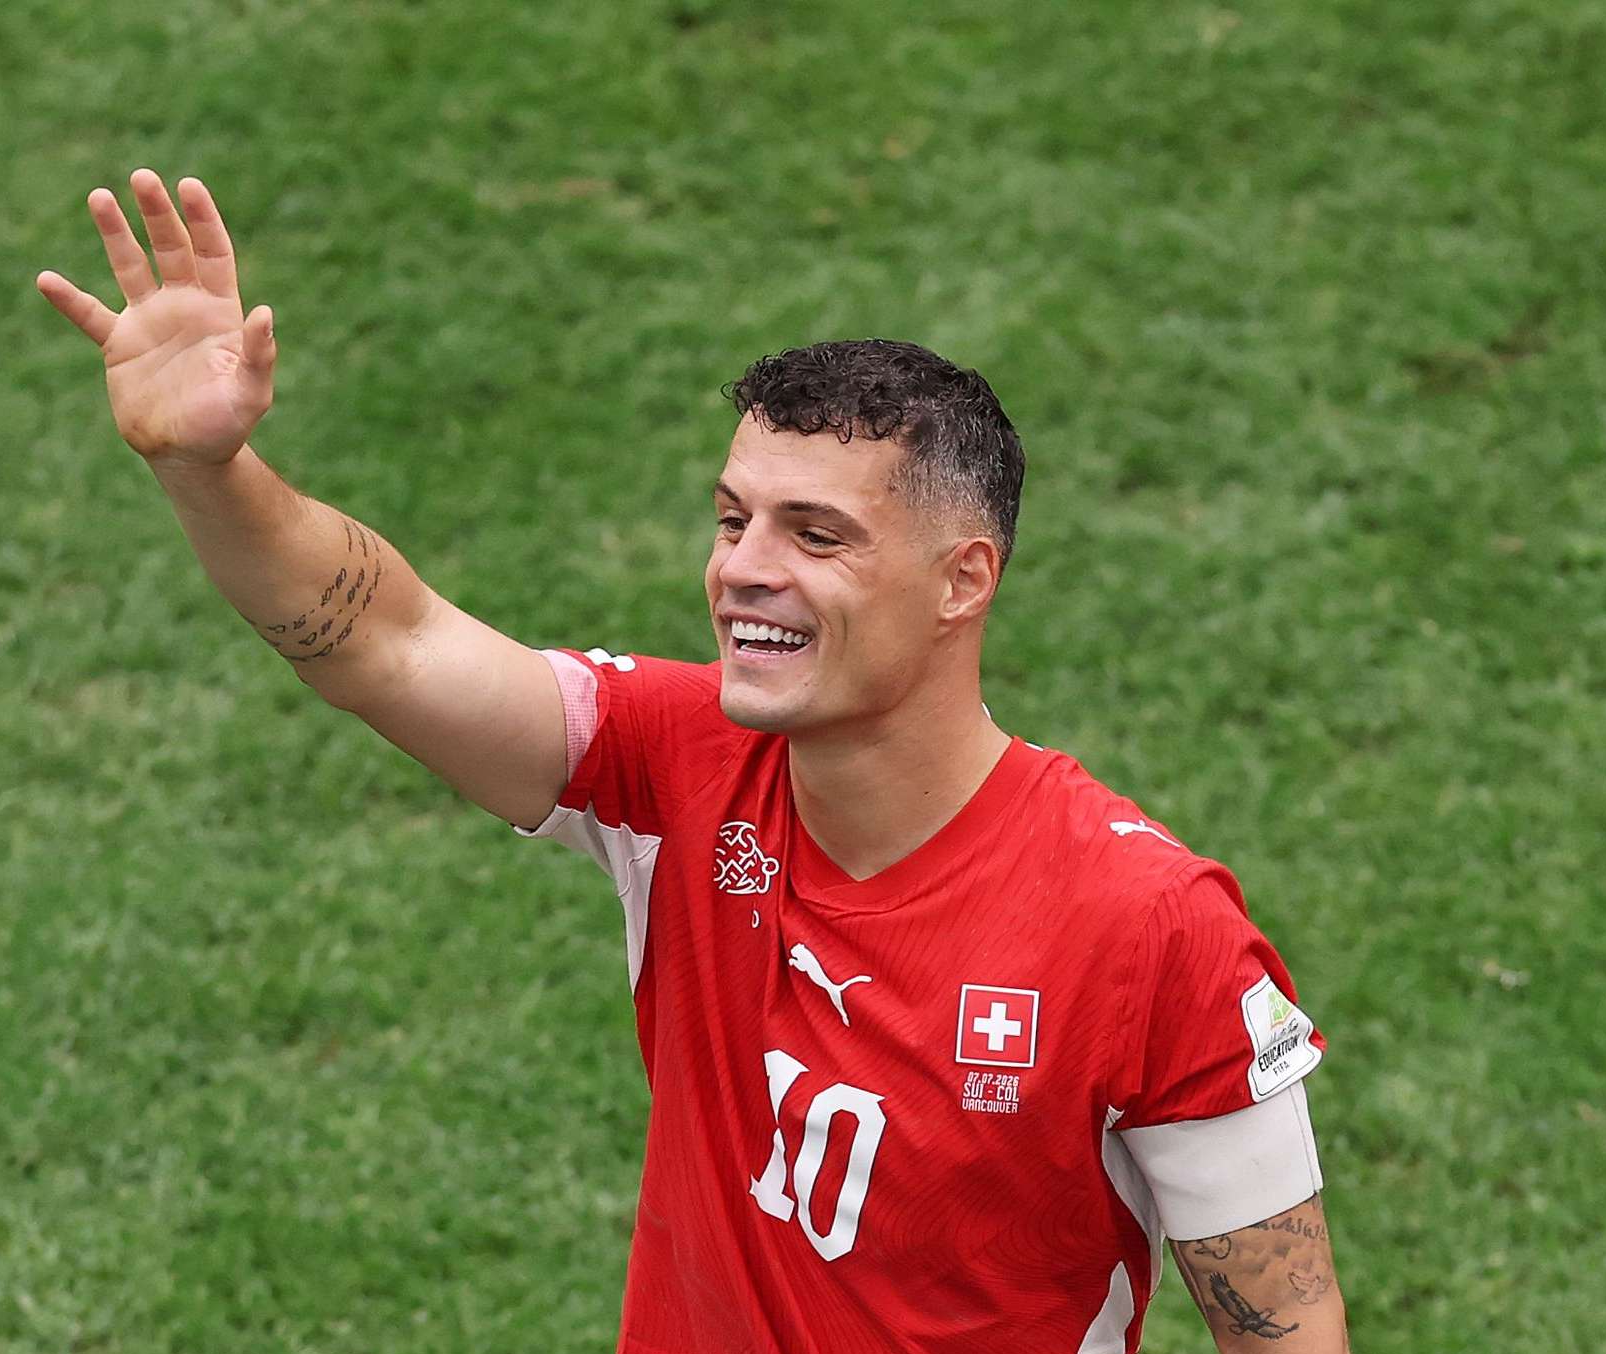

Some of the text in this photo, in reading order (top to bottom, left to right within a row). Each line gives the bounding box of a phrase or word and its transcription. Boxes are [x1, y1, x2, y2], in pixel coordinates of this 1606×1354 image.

[1258, 1034, 1300, 1072] EDUCATION
[1273, 1061, 1290, 1077] FIFA
[967, 1072, 1020, 1087] 07.07.2026
[963, 1082, 983, 1099] SUI
[997, 1085, 1020, 1102] COL
[962, 1098, 1018, 1113] VANCOUVER
[749, 1049, 887, 1262] 10
